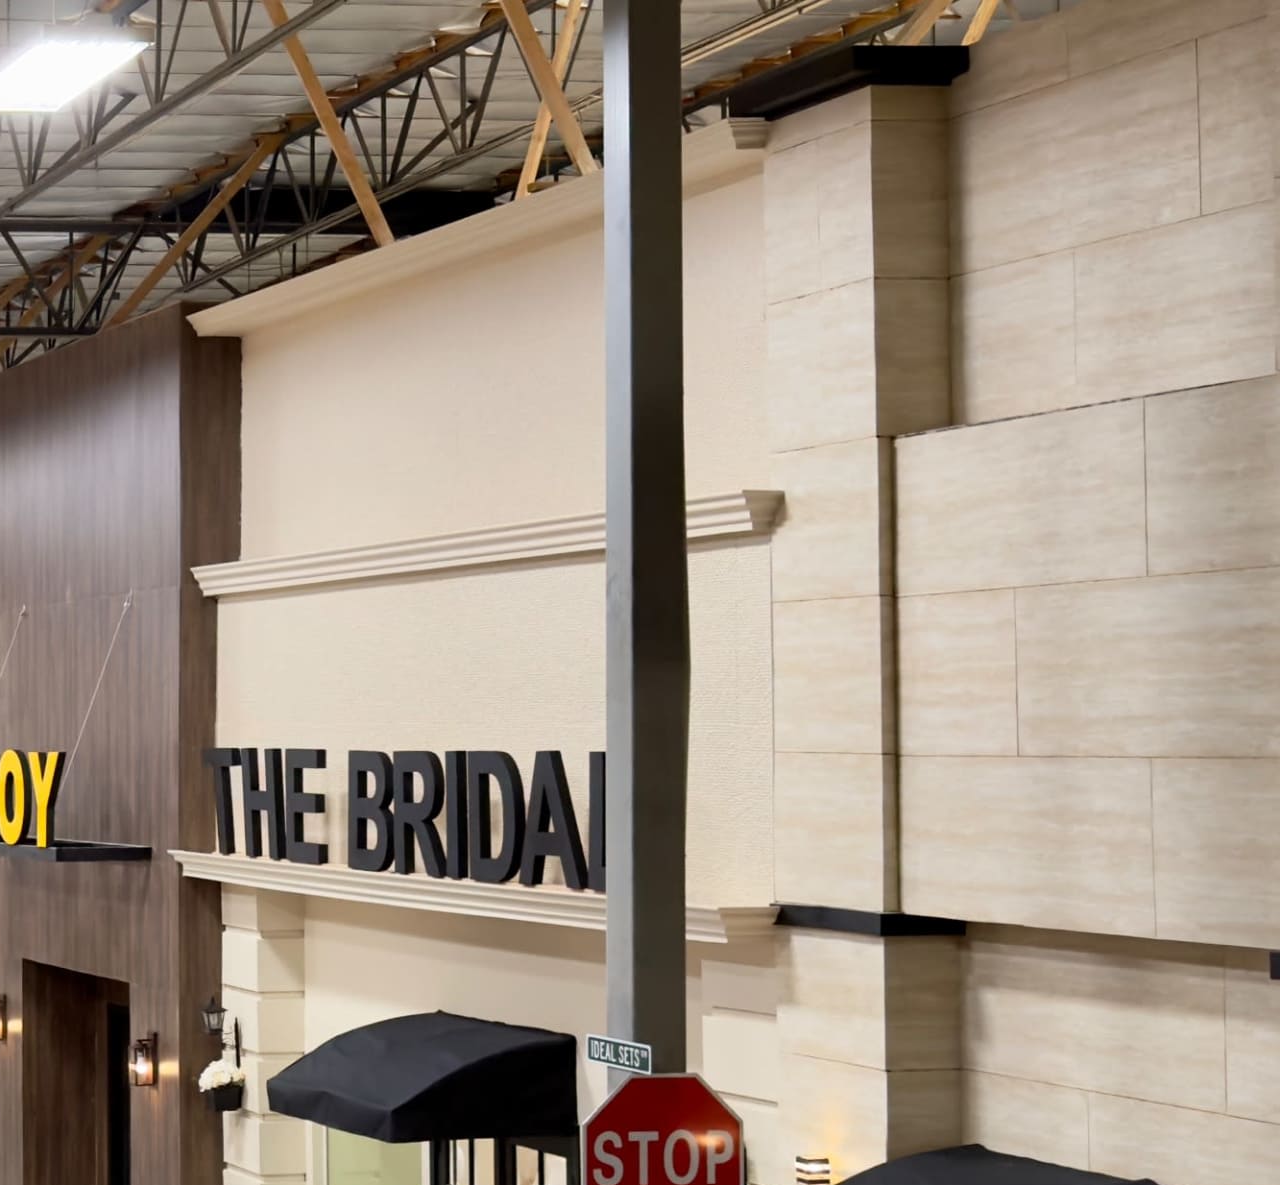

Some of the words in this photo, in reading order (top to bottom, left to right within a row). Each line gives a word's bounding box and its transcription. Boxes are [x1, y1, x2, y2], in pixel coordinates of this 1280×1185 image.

[203, 747, 326, 865] THE
[590, 1039, 617, 1063] IDEAL
[618, 1045, 640, 1068] SETS
